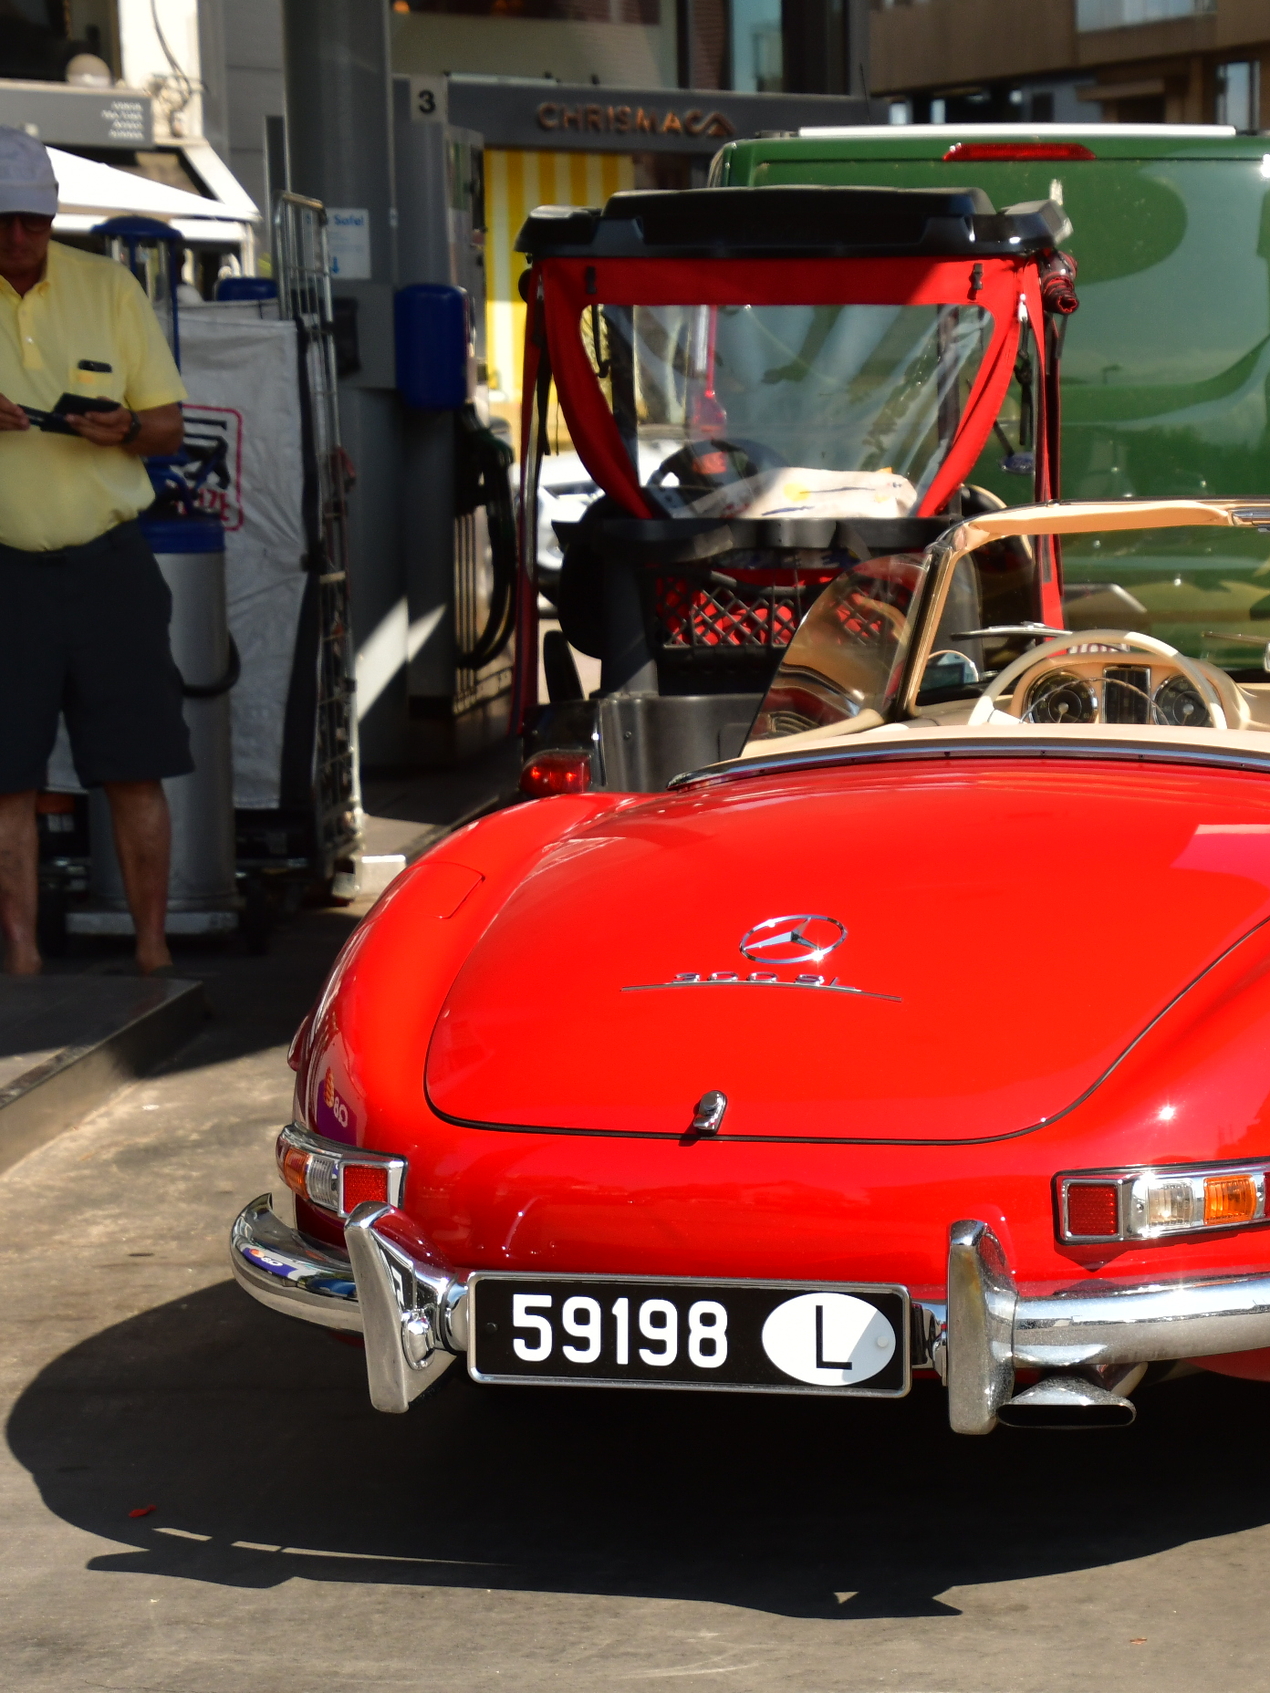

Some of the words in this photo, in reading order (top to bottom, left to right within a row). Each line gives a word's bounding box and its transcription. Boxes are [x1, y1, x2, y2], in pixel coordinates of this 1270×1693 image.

[418, 90, 436, 114] 3
[512, 1293, 728, 1369] 59198
[815, 1304, 853, 1371] L
